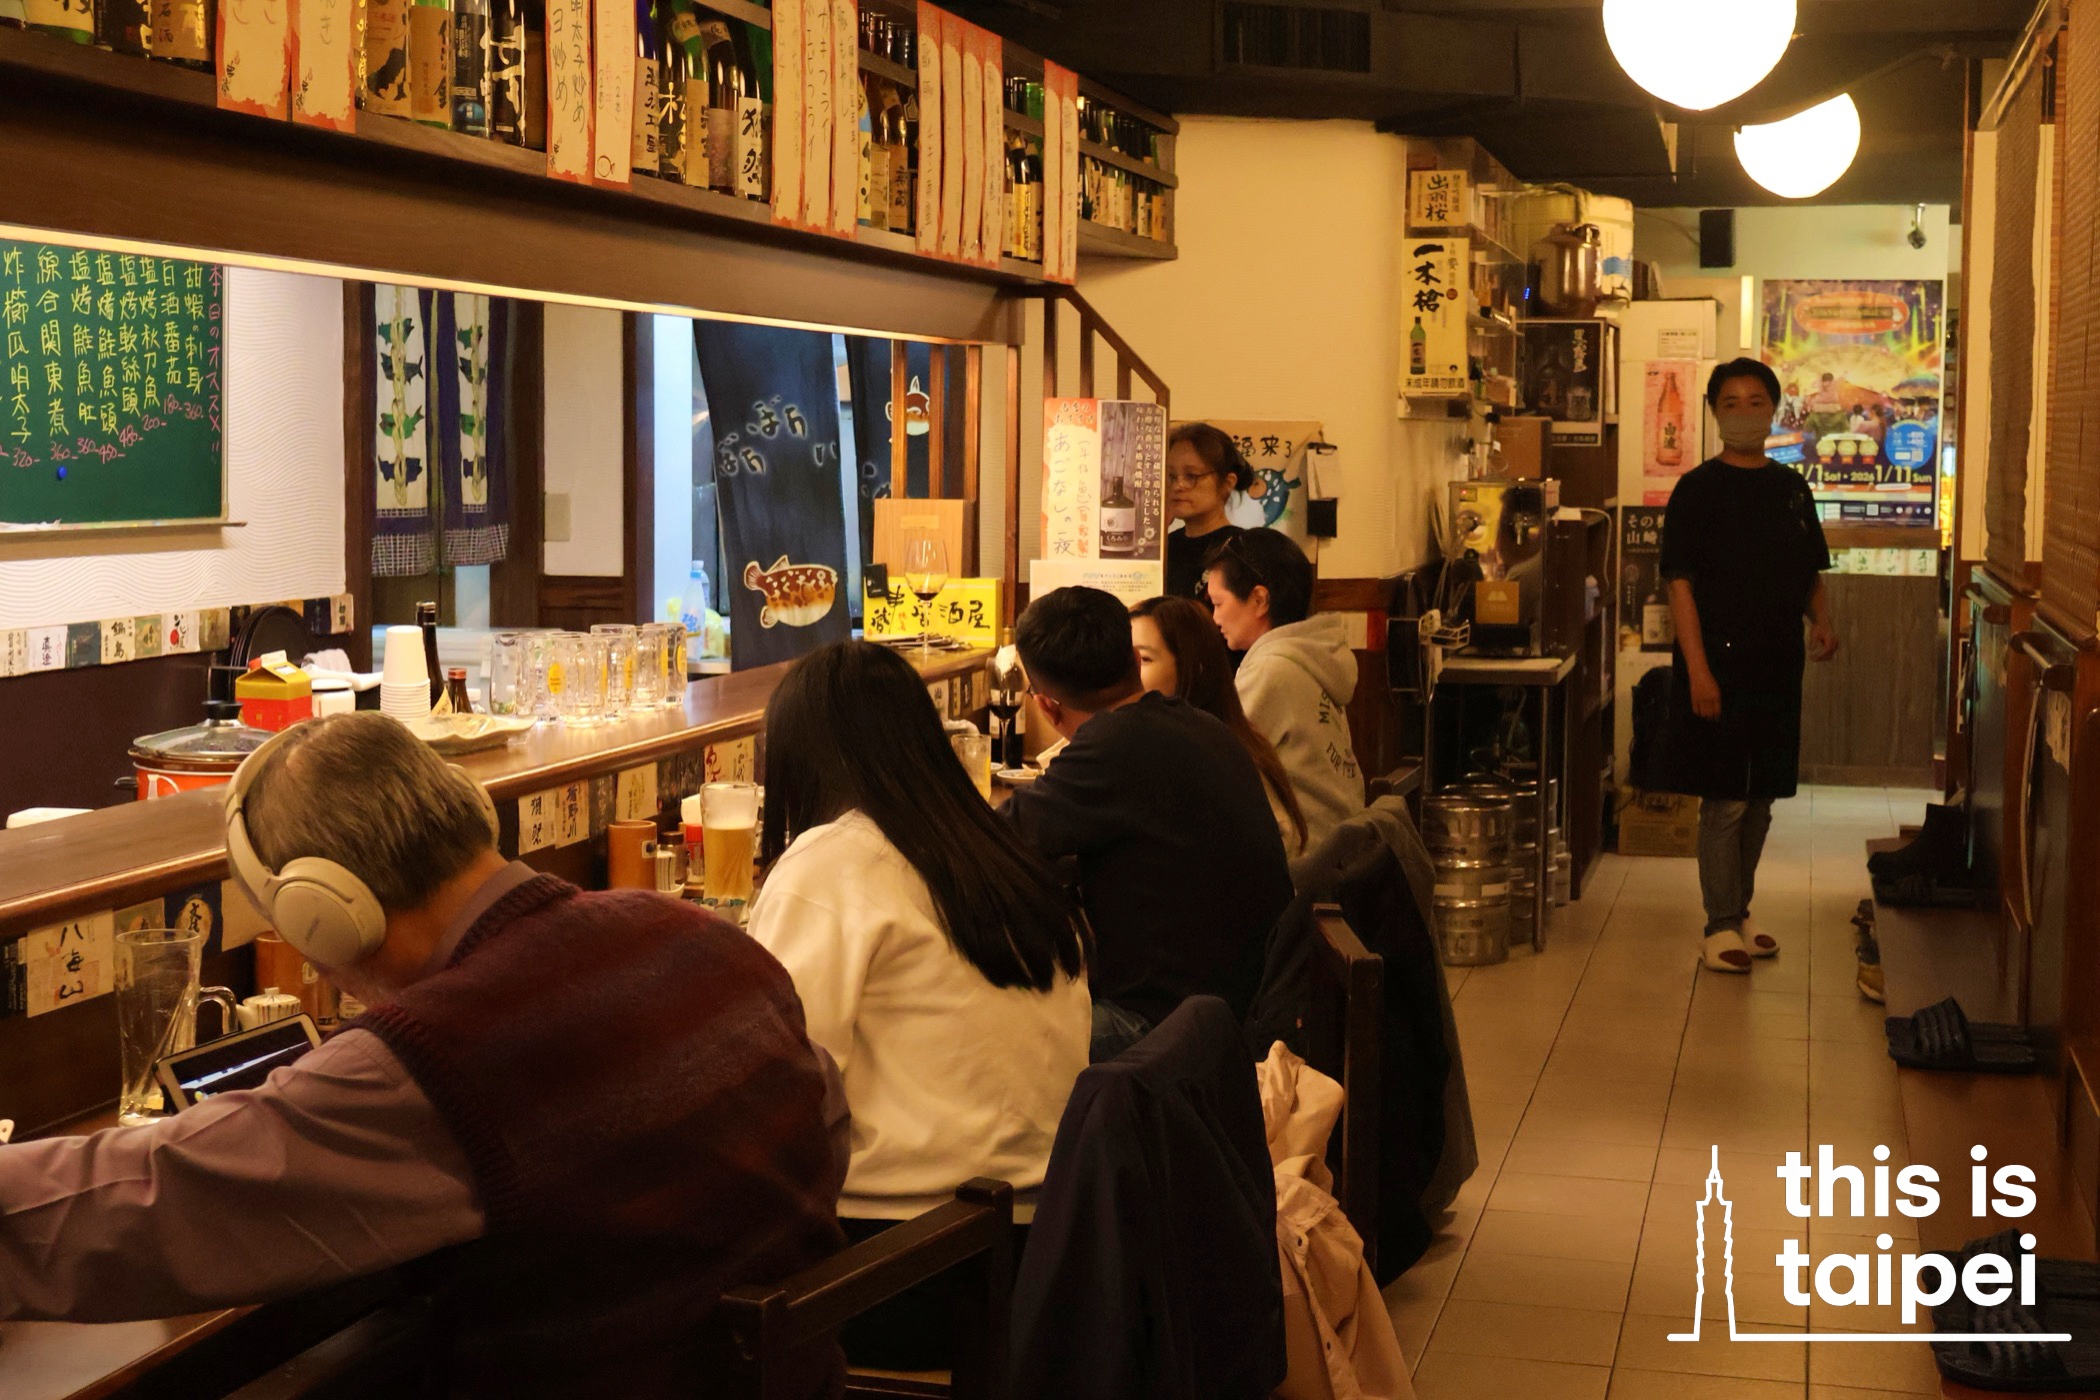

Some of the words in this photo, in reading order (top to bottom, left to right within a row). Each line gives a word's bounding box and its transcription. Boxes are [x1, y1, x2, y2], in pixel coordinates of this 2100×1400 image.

[1824, 472, 1842, 482] Sat
[1850, 471, 1875, 482] 2026
[1913, 473, 1933, 483] Sun
